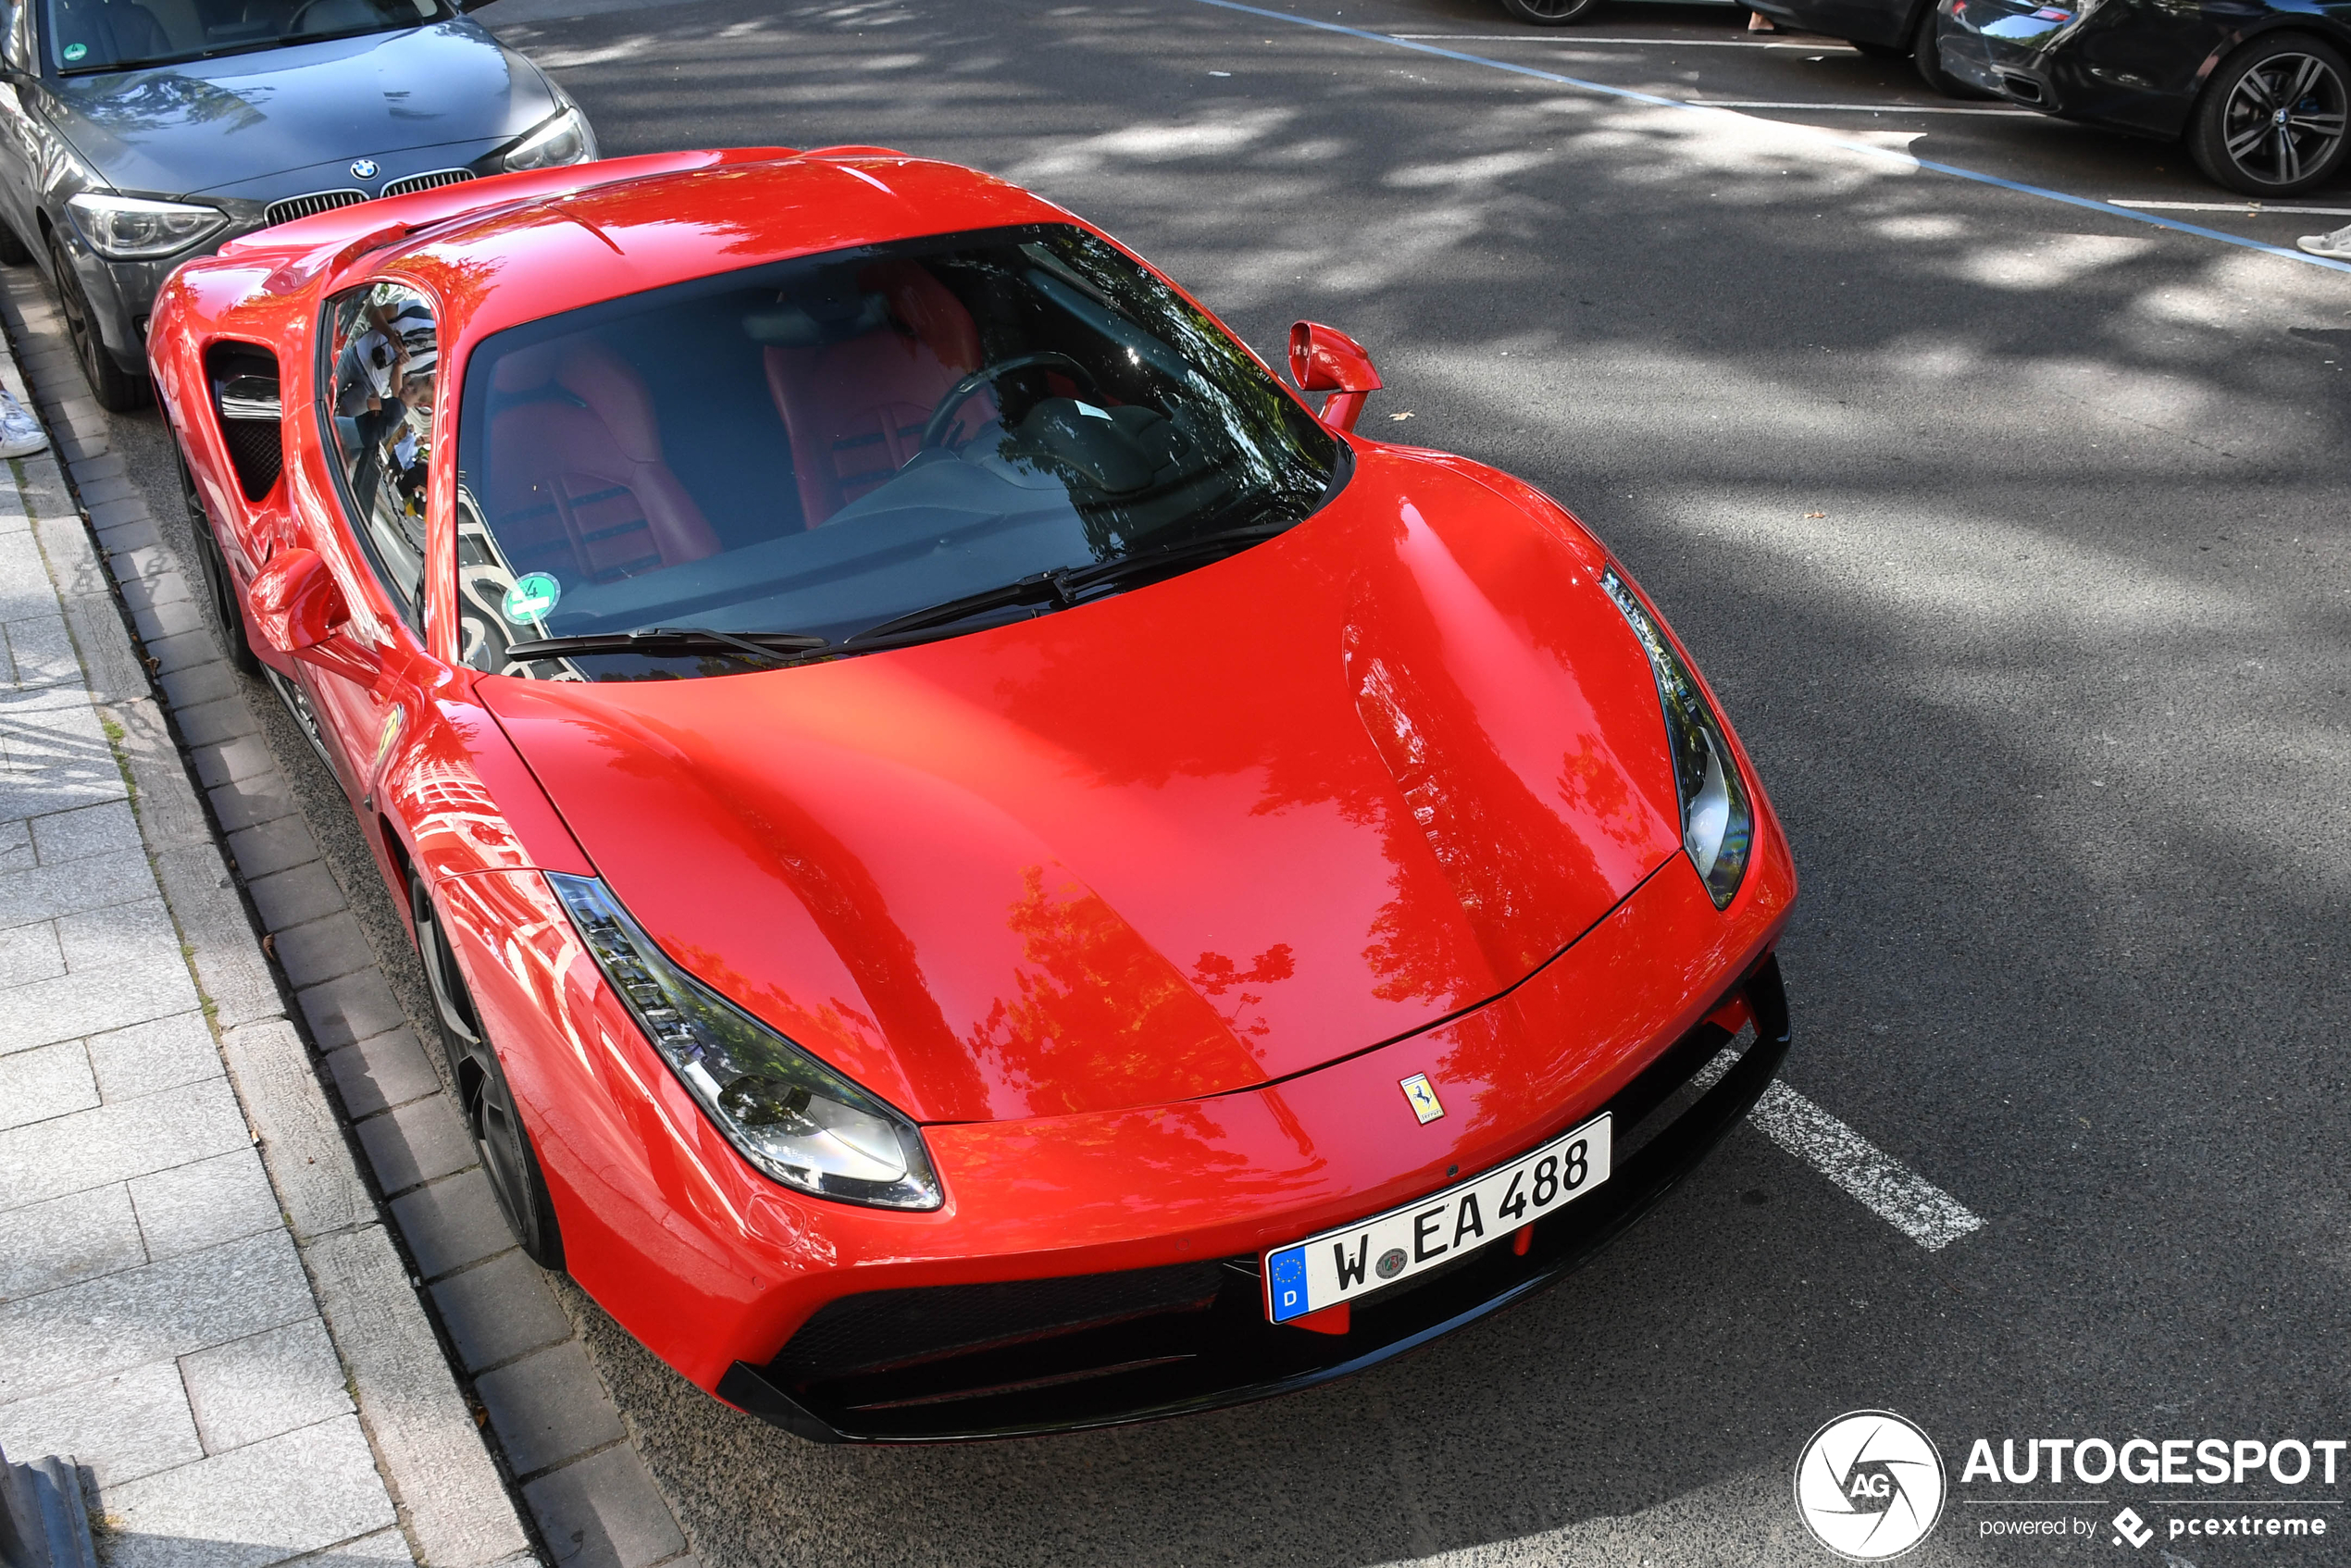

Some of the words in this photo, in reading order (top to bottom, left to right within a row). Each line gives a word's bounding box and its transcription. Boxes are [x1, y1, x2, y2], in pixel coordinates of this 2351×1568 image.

[525, 579, 538, 597] 4
[1333, 1234, 1369, 1291] W
[1414, 1192, 1485, 1263] EA
[1499, 1139, 1588, 1220] 488
[1284, 1290, 1297, 1307] D
